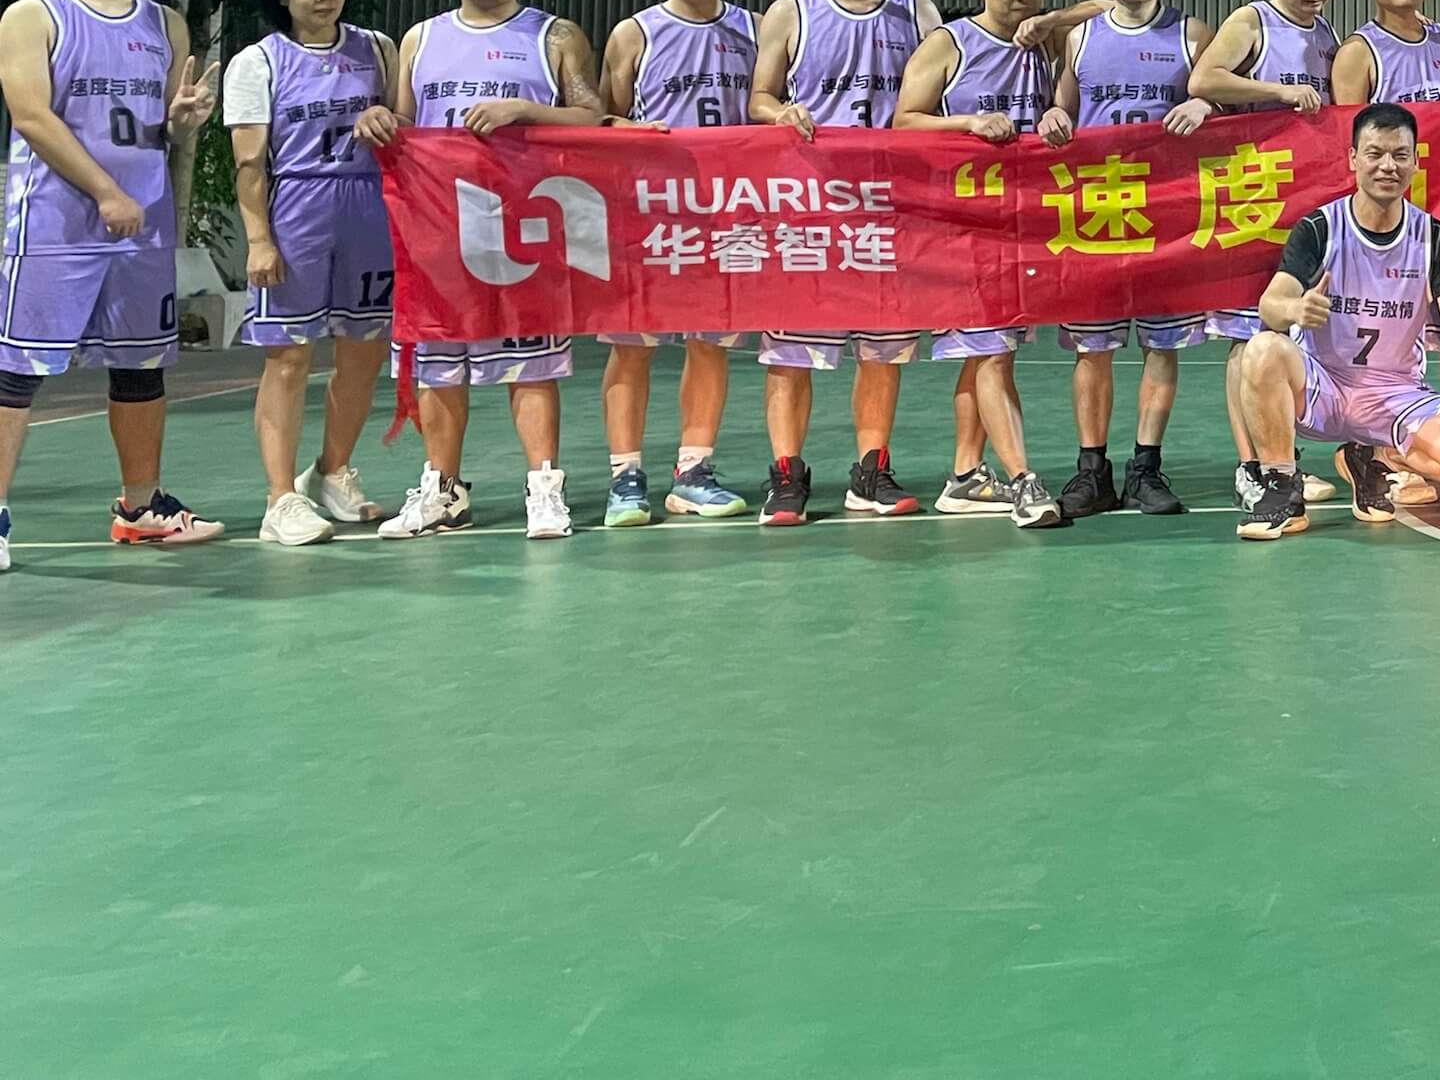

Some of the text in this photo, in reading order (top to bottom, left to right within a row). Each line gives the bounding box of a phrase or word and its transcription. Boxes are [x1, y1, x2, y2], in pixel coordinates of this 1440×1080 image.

[70, 77, 162, 100] 速度与激情
[423, 80, 521, 100] 速度与激情
[1090, 84, 1177, 102] 速度与激情
[109, 107, 137, 146] 0
[697, 97, 722, 127] 6
[850, 100, 872, 128] 3
[320, 125, 357, 163] 17
[635, 176, 895, 215] HUARISE
[642, 222, 897, 276] 华睿智连
[358, 270, 392, 307] 17
[160, 292, 175, 331] 0
[1328, 295, 1415, 320] 速度与激情
[1352, 327, 1380, 366] 7
